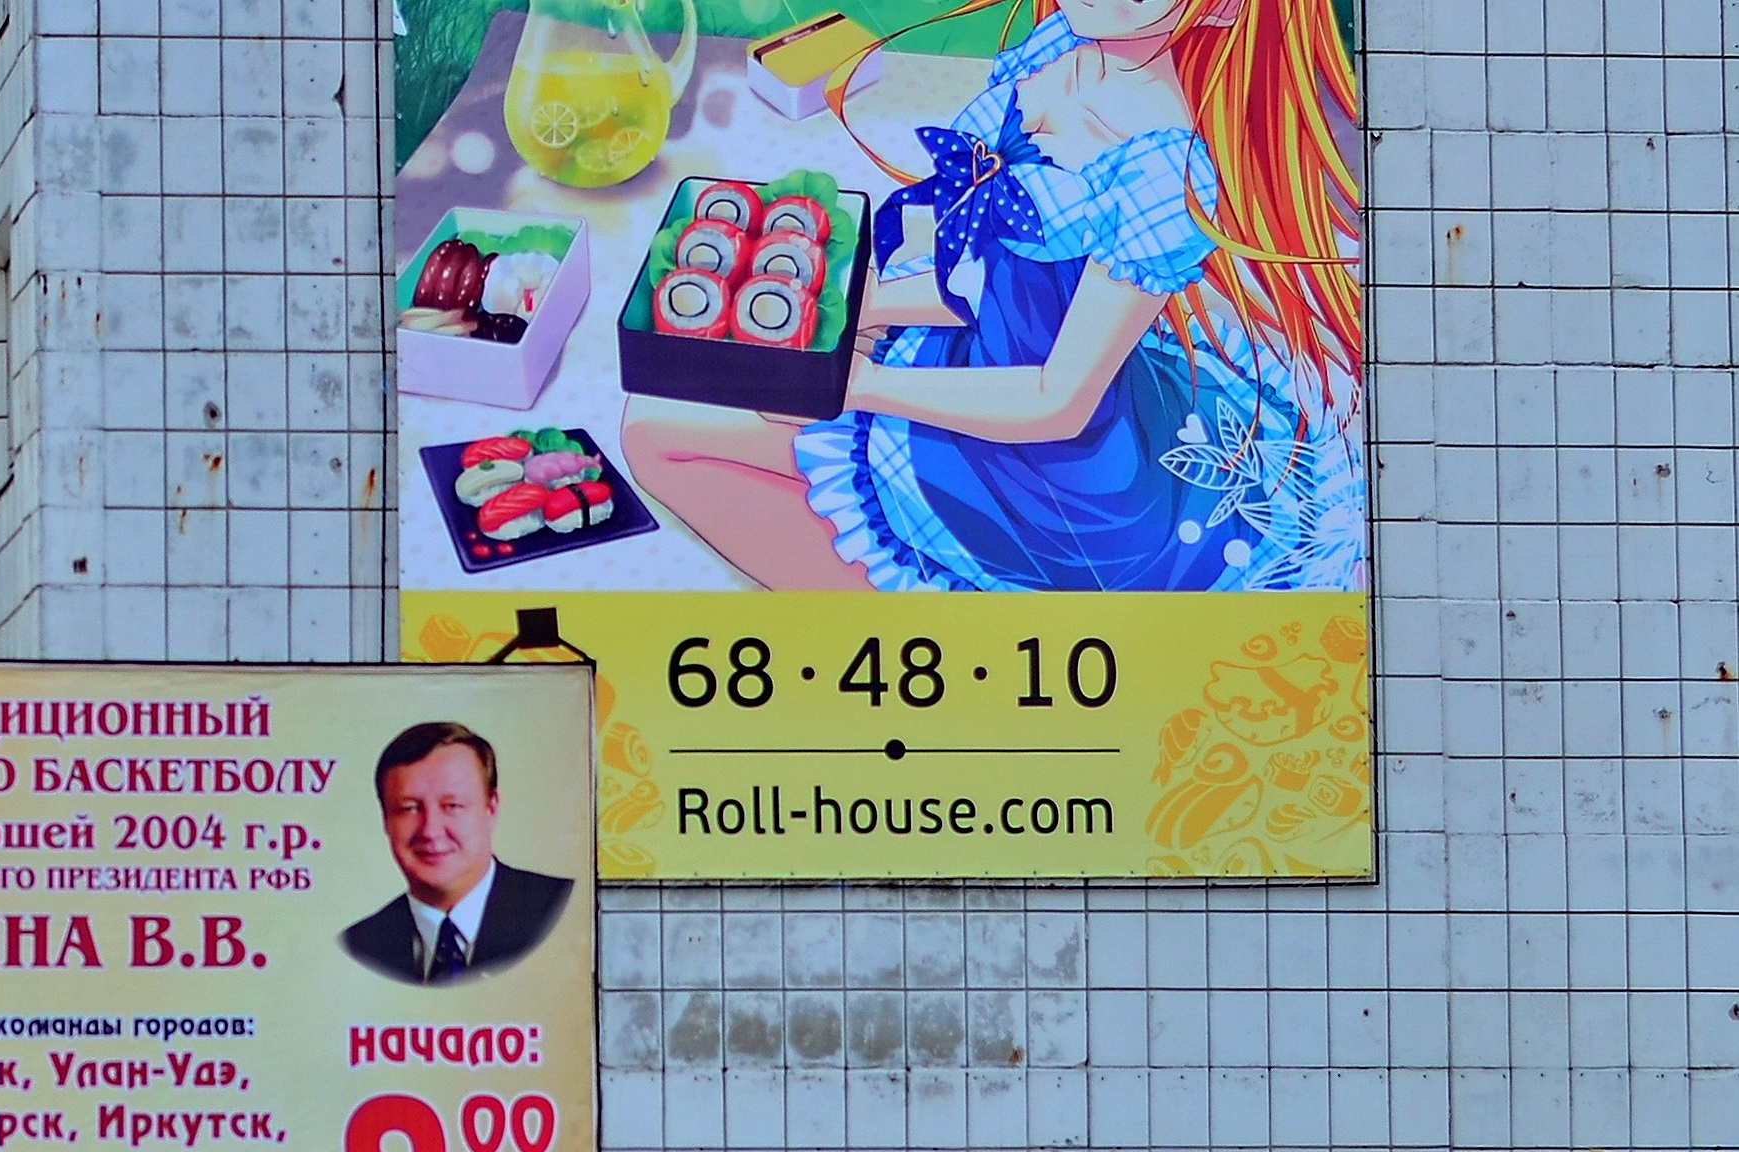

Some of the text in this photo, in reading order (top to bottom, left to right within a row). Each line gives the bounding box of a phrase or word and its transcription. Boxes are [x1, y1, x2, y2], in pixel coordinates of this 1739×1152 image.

[34, 758, 336, 794] БАСКЕТБОЛУ
[678, 785, 1113, 835] Roll-house.com
[114, 814, 226, 850] 2004
[245, 824, 321, 860] г.р.
[47, 867, 238, 892] ПРЕЗИДЕНТА
[250, 868, 311, 890] РФБ
[130, 915, 267, 969] В.В.
[133, 1018, 254, 1042] городов:
[350, 1026, 540, 1067] начало:
[49, 1052, 249, 1091] Улан-Удэ,
[99, 1104, 286, 1147] Иркутск,
